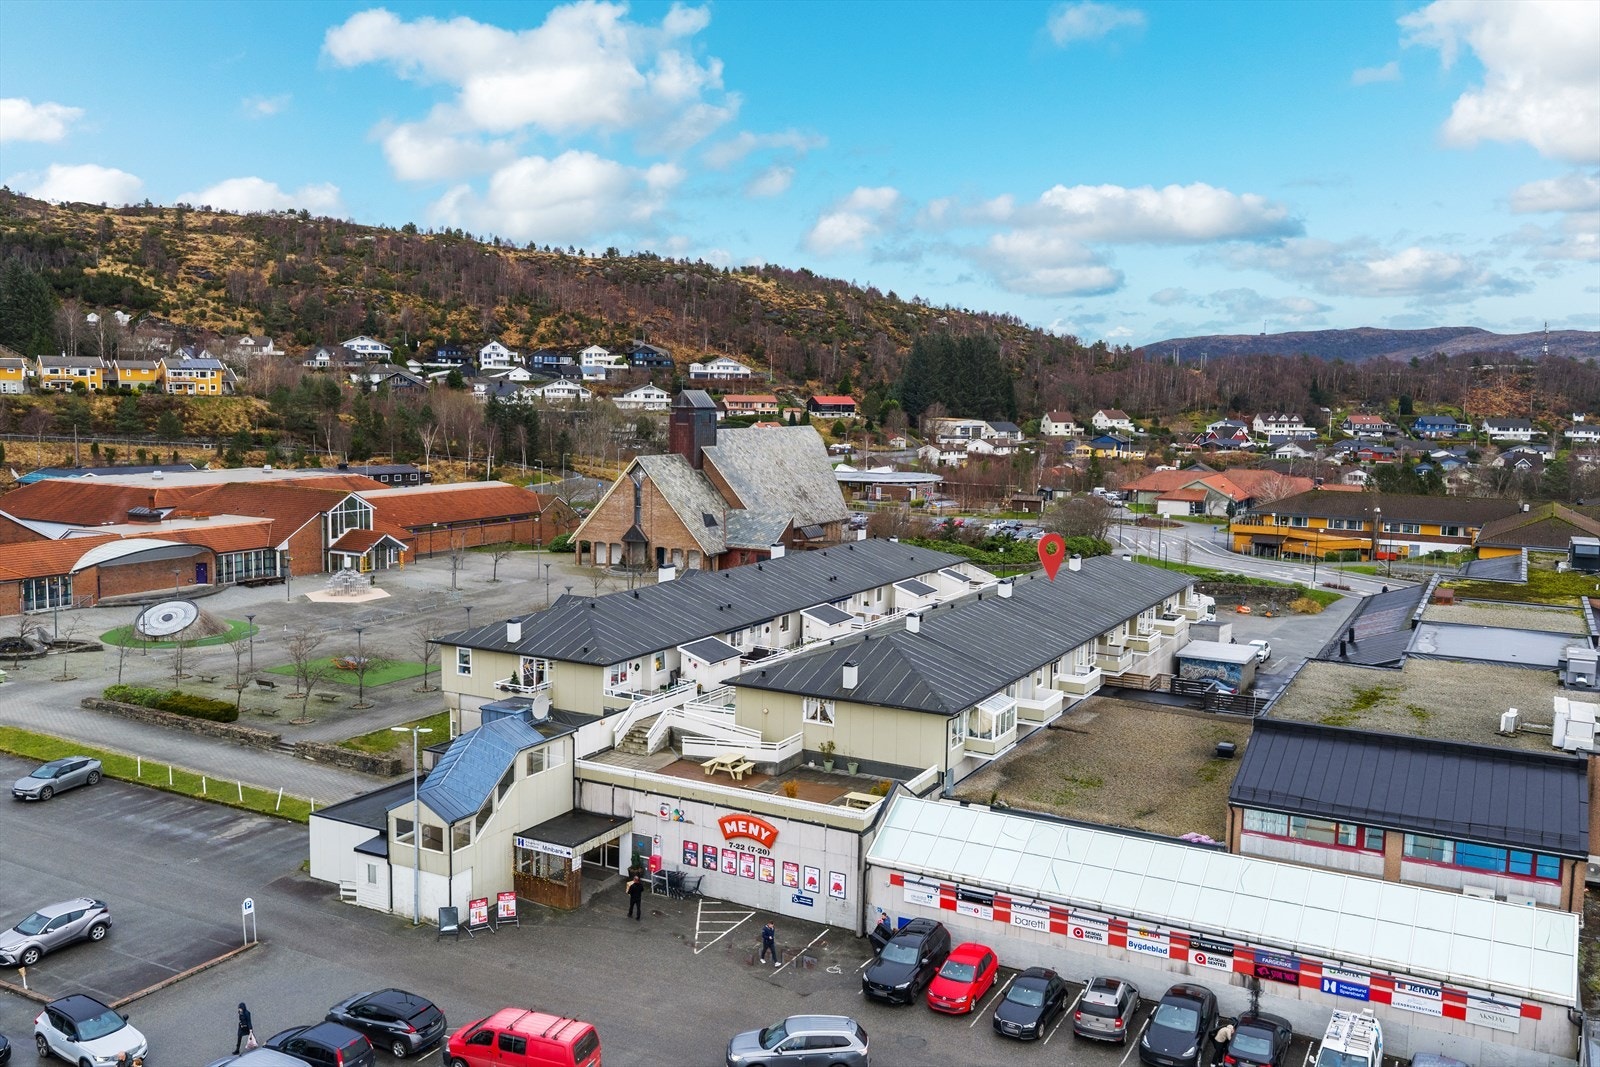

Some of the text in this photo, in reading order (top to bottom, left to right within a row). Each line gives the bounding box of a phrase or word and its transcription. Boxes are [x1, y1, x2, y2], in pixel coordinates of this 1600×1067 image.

[724, 820, 771, 840] MENY
[729, 842, 770, 856] 7-22 (7-20)
[1014, 914, 1046, 930] baretti
[1128, 940, 1168, 955] Bygdeblad
[1262, 958, 1292, 968] FARGERIKE
